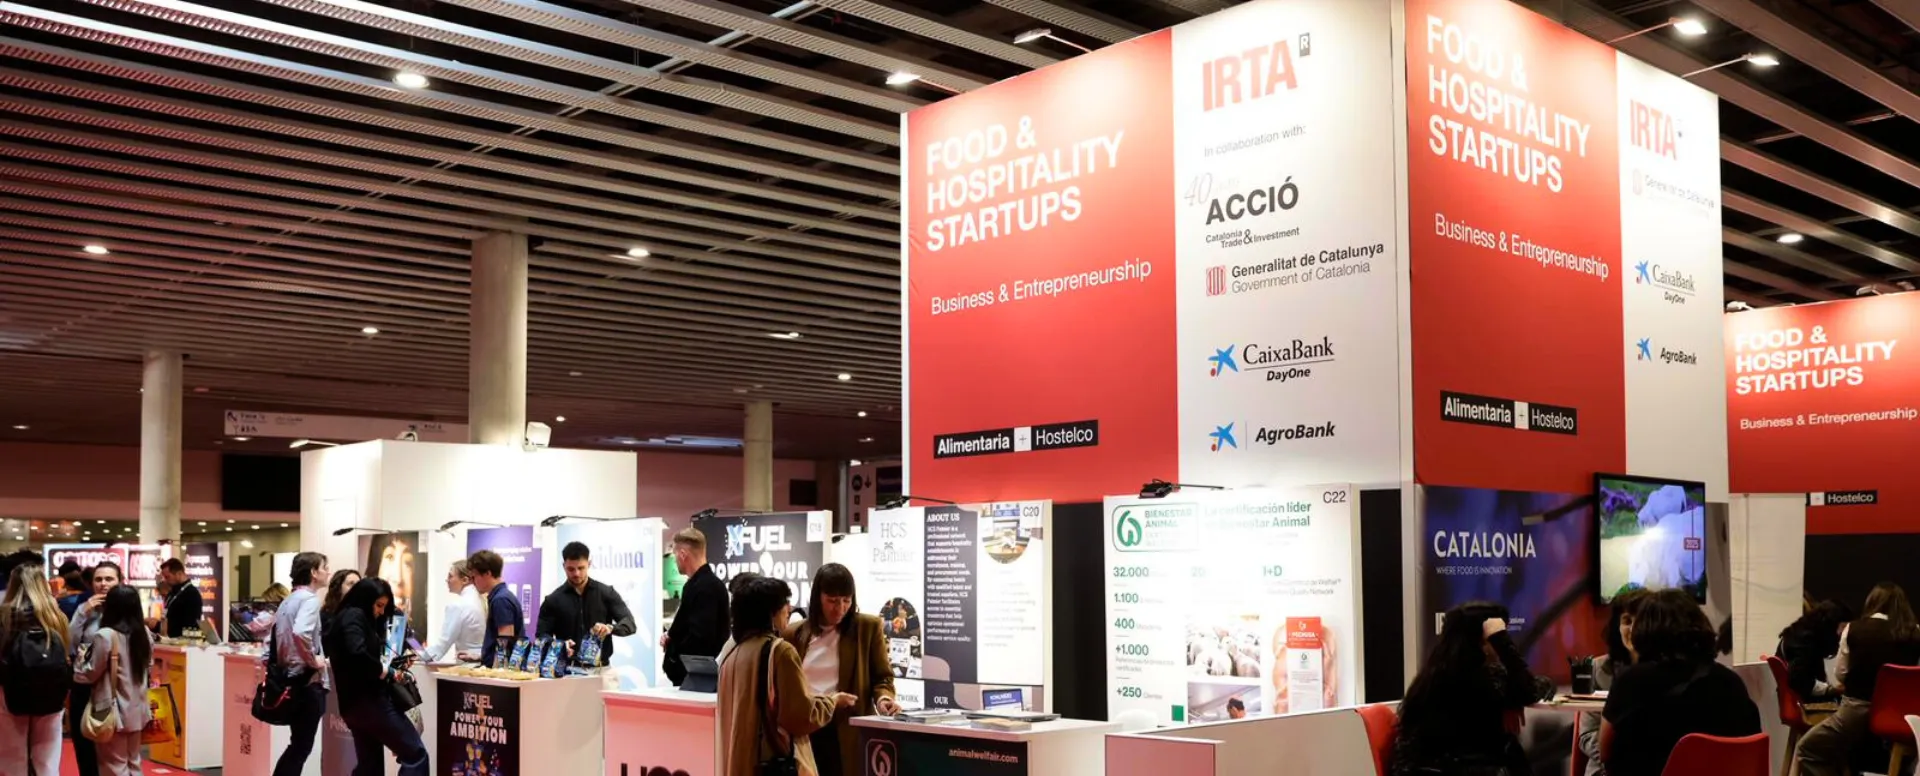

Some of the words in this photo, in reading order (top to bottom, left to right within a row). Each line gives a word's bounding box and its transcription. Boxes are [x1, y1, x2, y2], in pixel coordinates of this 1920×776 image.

[1427, 13, 1505, 80] FOOD
[1511, 52, 1529, 93] &
[1202, 39, 1298, 112] IRTA
[1428, 63, 1591, 158] HOSPITALITY
[1204, 146, 1214, 158] In
[1215, 132, 1280, 156] collaboration
[1282, 124, 1307, 140] with:
[1630, 98, 1677, 161] IRTA
[926, 124, 1008, 176] FOOD
[1016, 115, 1037, 150] &
[1429, 115, 1563, 193] STARTUPS
[926, 129, 1125, 215] HOSPITALITY
[1205, 176, 1299, 226] ACCIÓ
[926, 186, 1082, 252] STARTUPS
[1205, 230, 1243, 244] Catalonia
[1221, 238, 1242, 249] Trade
[1243, 229, 1254, 245] &
[1254, 227, 1300, 243] Investment
[1434, 212, 1496, 250] Business
[1498, 231, 1509, 253] &
[1511, 233, 1609, 282] Entrepreneurship
[1231, 257, 1297, 279] Generalitat
[1299, 253, 1316, 267] de
[1319, 243, 1385, 265] Catalunya
[931, 289, 995, 316] Business
[998, 284, 1009, 303] &
[1013, 258, 1152, 300] Entrepreneurship
[1231, 273, 1298, 294] Government
[1301, 269, 1313, 283] of
[1315, 261, 1371, 281] Catalonia
[1652, 264, 1695, 292] CaixaBank
[1243, 336, 1335, 365] CaixaBank
[1735, 328, 1804, 352] FOOD
[1810, 325, 1828, 344] &
[1660, 347, 1697, 365] AgroBank
[1735, 339, 1897, 374] HOSPITALITY
[1266, 367, 1312, 383] DayOne
[1735, 366, 1864, 396] STARTUPS
[1444, 396, 1512, 424] Alimentaria
[1531, 408, 1574, 431] Hostelco
[1740, 418, 1794, 430] Business
[1796, 414, 1806, 426] &
[1808, 407, 1918, 426] Entrepreneurship
[937, 433, 1010, 455] Alimentaria
[1036, 427, 1094, 446] Hostelco
[1255, 421, 1336, 446] AgroBank
[1322, 491, 1347, 504] C22
[1827, 492, 1874, 504] Hostelco
[926, 513, 950, 523] ABOUT
[950, 512, 960, 521] US
[1022, 506, 1039, 518] C20
[1144, 508, 1192, 519] BIENESTAR
[1272, 515, 1311, 528] Animal
[880, 522, 908, 539] HCS
[1434, 530, 1536, 558] CATALONIA
[1113, 566, 1149, 578] 32.000
[1263, 565, 1283, 577] I+D
[1436, 566, 1456, 575] WHERE
[1457, 566, 1474, 575] FOOD
[1480, 565, 1513, 575] INNOVATION
[1114, 592, 1139, 604] 1.100
[1114, 617, 1135, 629] 400
[1116, 643, 1149, 656] +1.000
[933, 695, 949, 705] OUR
[1117, 686, 1142, 698] +250
[450, 721, 507, 745] AMBITION
